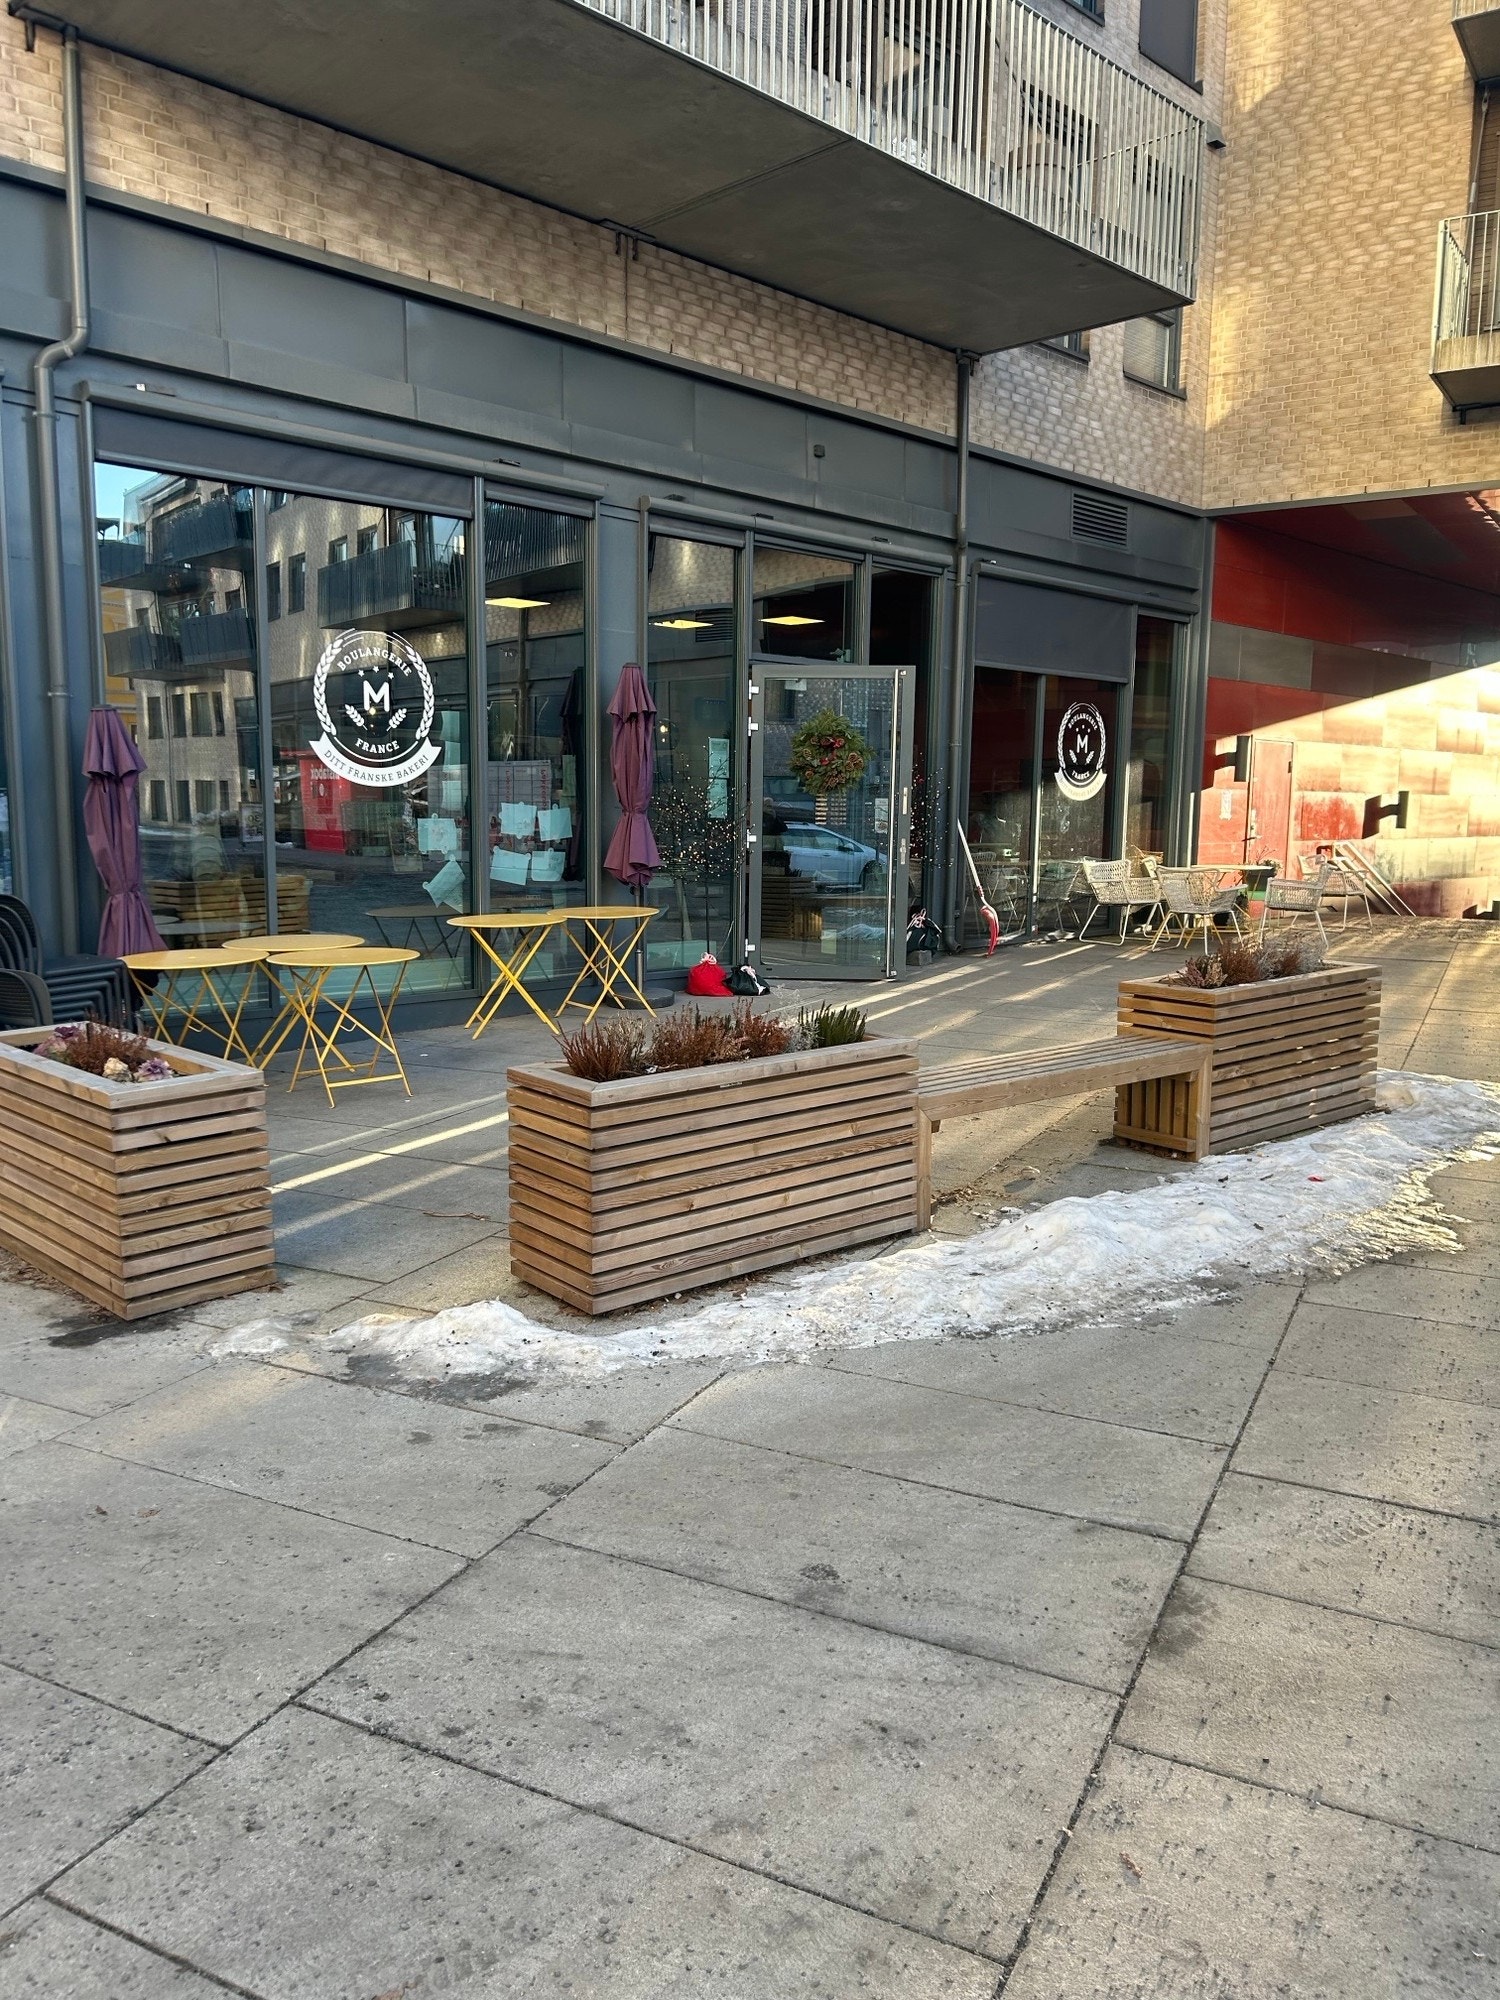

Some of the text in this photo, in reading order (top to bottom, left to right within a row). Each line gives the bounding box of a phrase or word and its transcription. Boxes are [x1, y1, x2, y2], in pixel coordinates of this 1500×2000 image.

[337, 647, 412, 677] BOULANGERIE
[363, 680, 390, 712] M
[355, 738, 400, 753] FRANCE
[1077, 734, 1088, 753] M
[324, 750, 347, 770] DITT
[348, 767, 394, 781] FRANSKE
[396, 754, 429, 776] BAKERI
